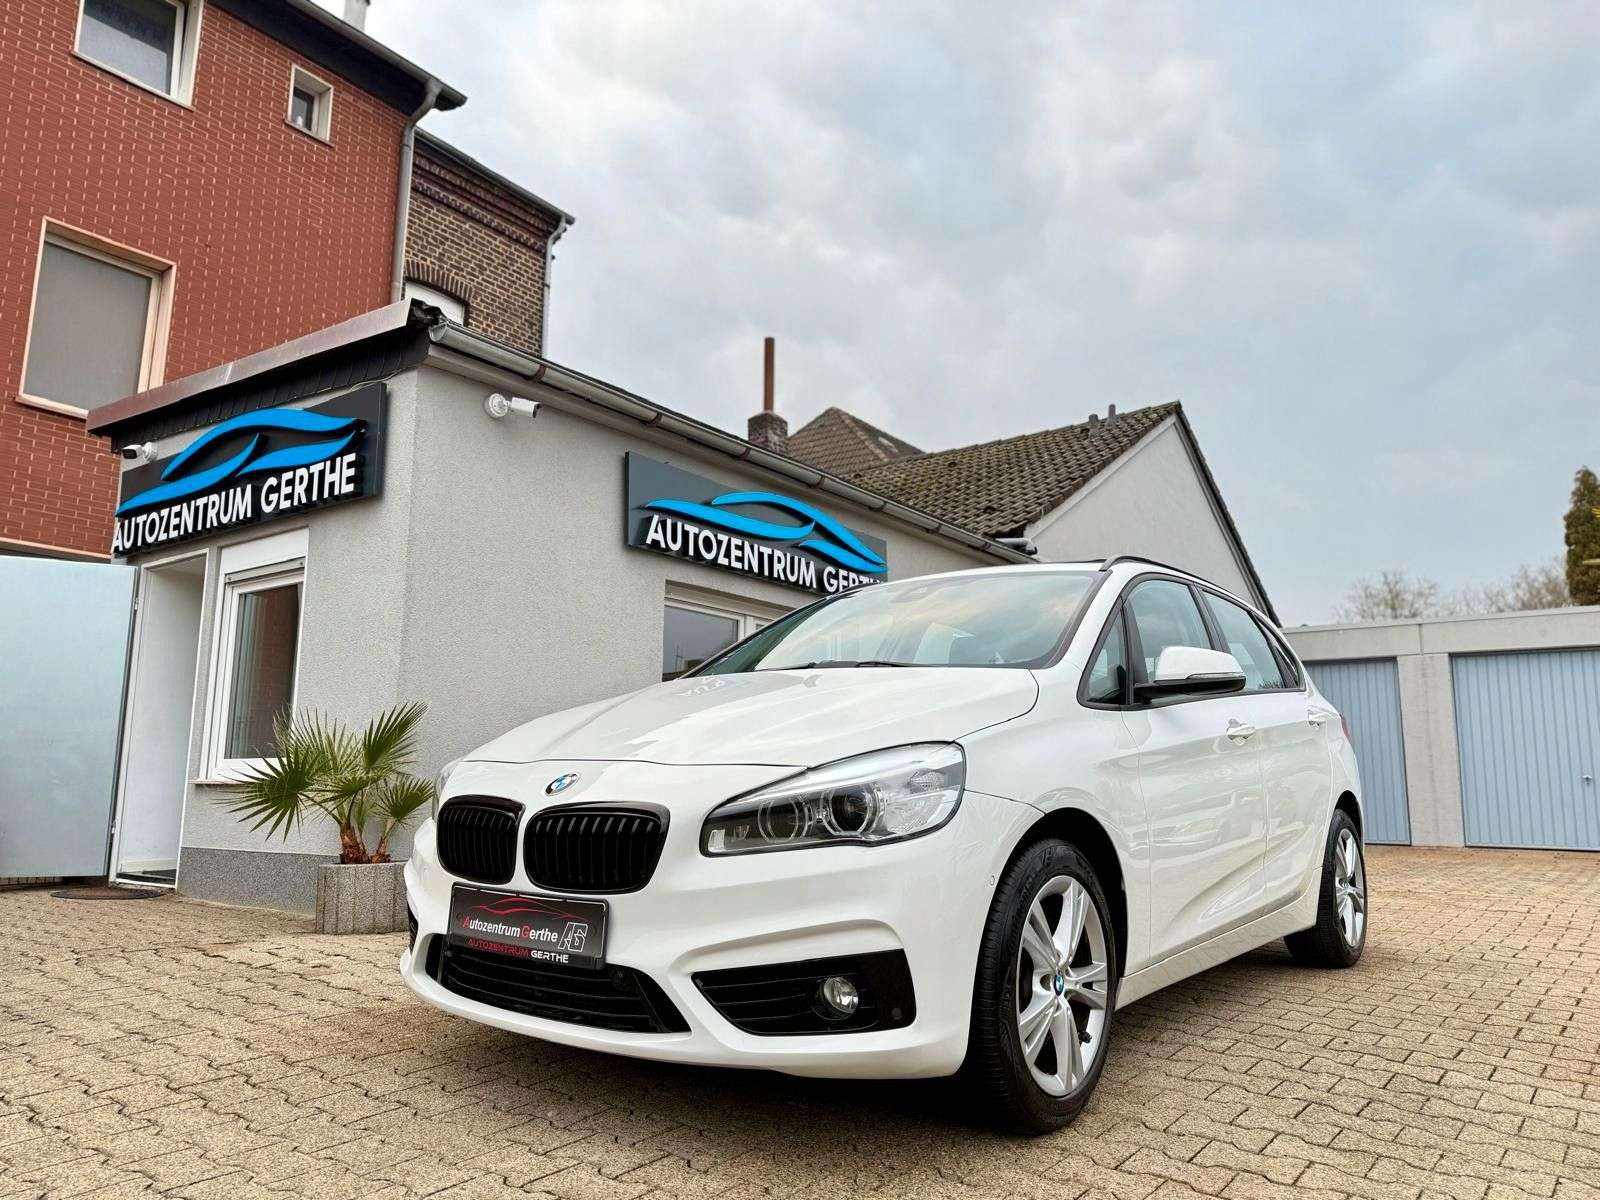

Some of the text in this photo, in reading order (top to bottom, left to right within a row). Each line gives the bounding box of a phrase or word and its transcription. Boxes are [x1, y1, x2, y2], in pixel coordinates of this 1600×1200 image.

[112, 452, 356, 552] AUTOZENTRUM GERTHE
[646, 514, 881, 592] AUTOZENTRUM GER
[468, 938, 569, 963] AUTOZENTRUM GERTHE
